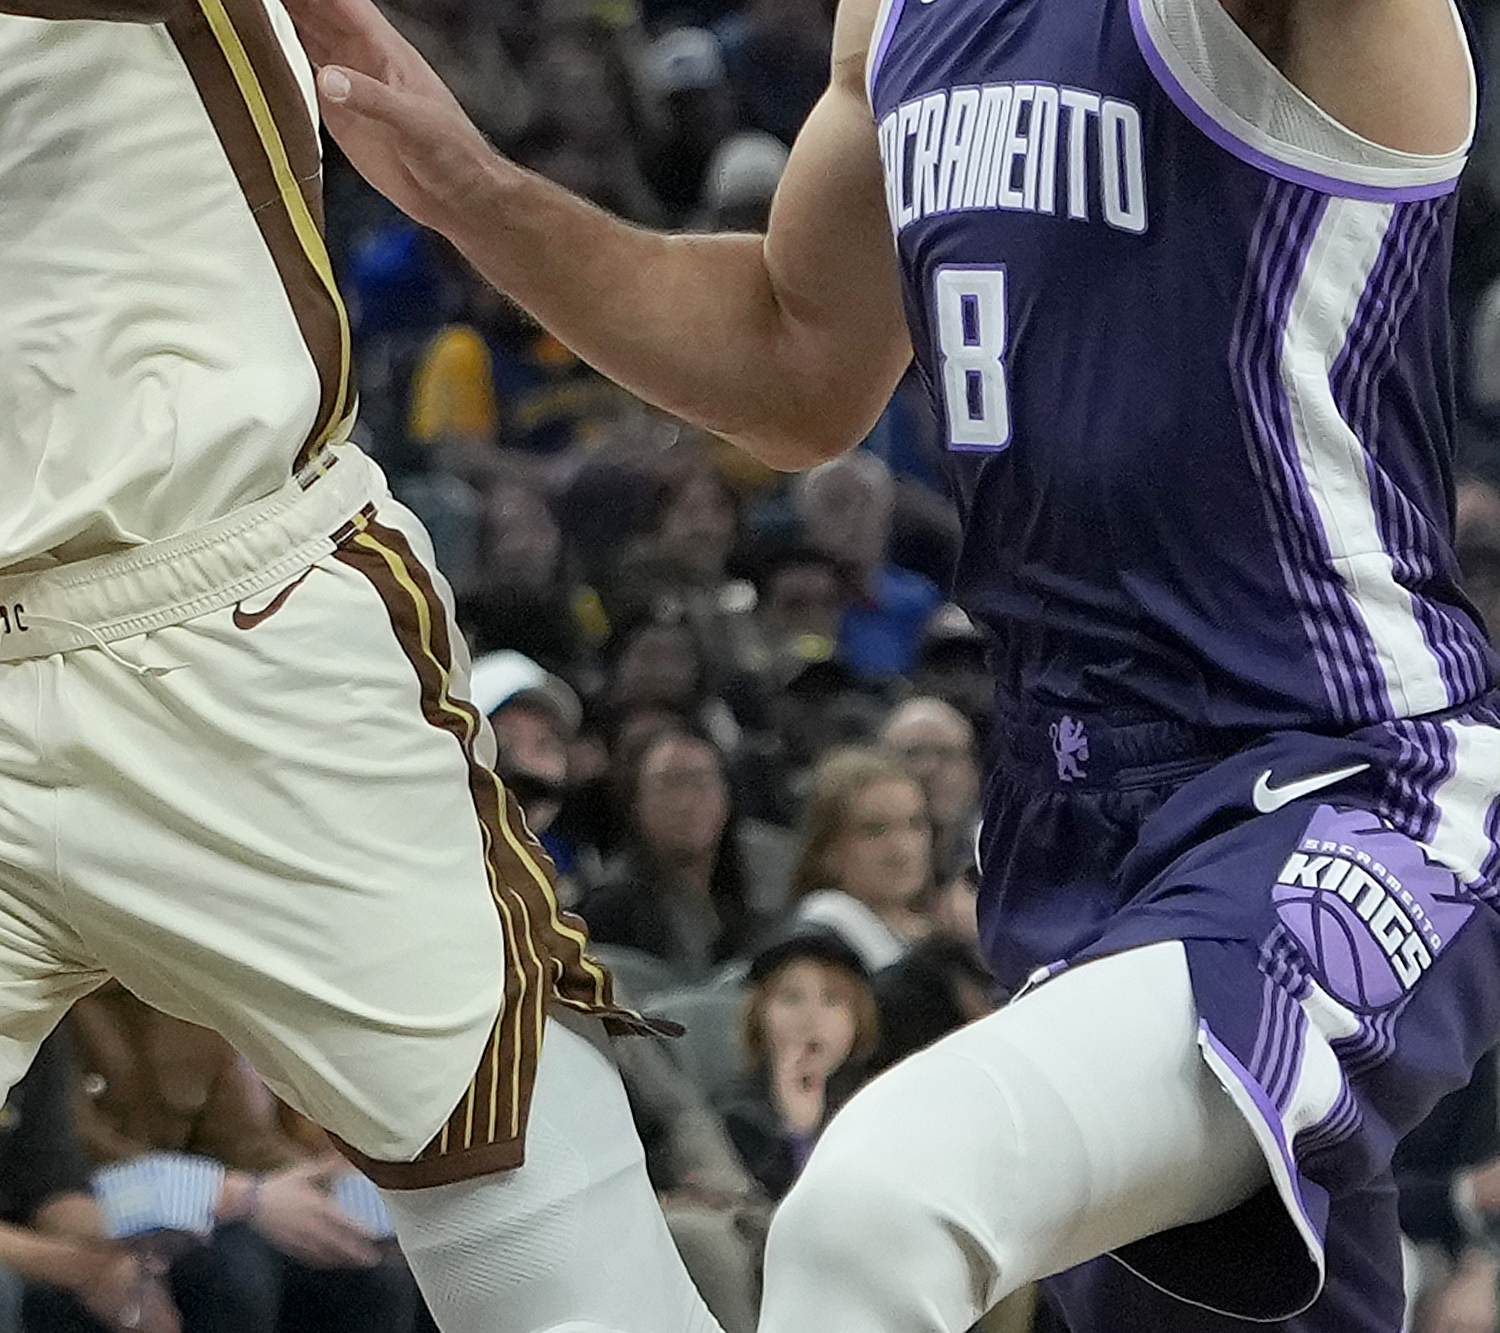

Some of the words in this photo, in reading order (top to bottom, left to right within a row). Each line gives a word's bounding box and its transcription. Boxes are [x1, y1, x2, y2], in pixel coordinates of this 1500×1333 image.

[879, 82, 1148, 255] ACRAMENTO
[935, 264, 1011, 453] 8
[1279, 852, 1433, 990] KINGS
[1303, 839, 1442, 950] SACRAMENTO
